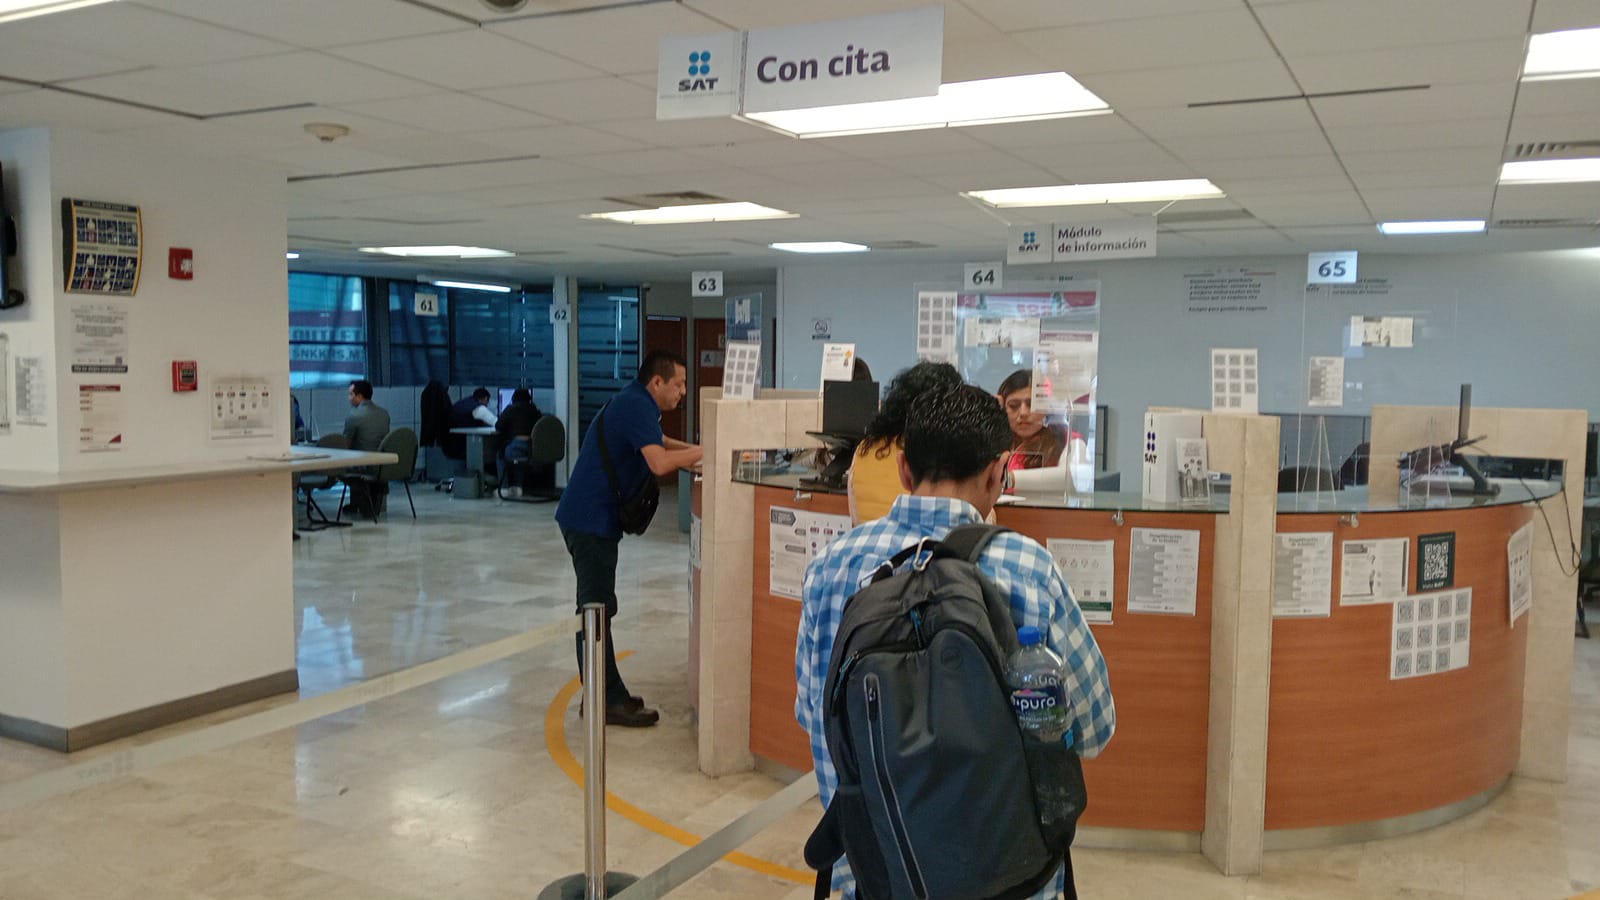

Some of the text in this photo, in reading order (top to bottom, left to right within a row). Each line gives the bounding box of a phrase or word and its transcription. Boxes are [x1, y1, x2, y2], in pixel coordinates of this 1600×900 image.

[757, 43, 891, 84] Con cita
[678, 77, 719, 92] SAT
[1058, 226, 1102, 239] Módulo
[1018, 243, 1041, 252] SAT
[1057, 237, 1147, 253] de información
[1318, 260, 1346, 277] 65
[971, 269, 995, 285] 64
[698, 278, 717, 291] 63
[420, 300, 434, 313] 61
[553, 309, 568, 321] 62
[1145, 453, 1158, 465] SAT
